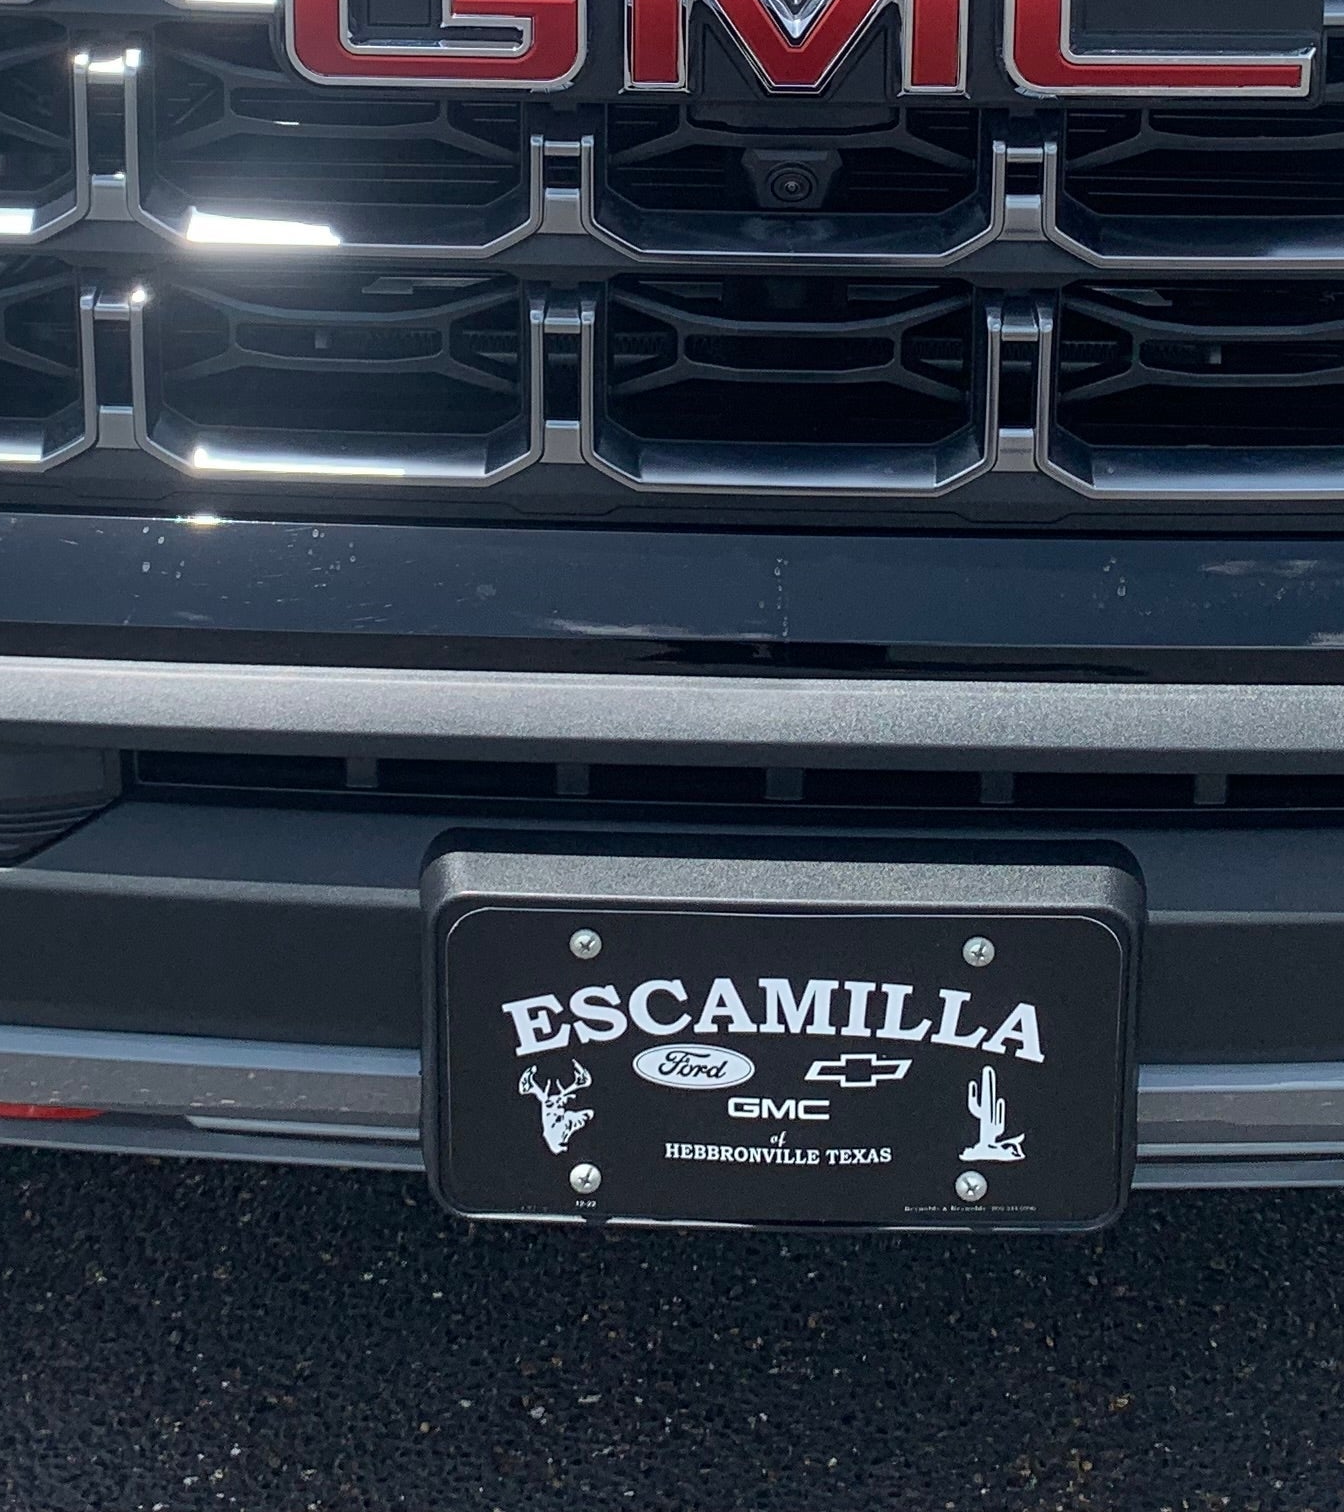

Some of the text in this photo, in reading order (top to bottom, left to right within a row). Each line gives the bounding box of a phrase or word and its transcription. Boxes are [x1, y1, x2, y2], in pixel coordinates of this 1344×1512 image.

[501, 977, 1045, 1063] ESCAMILLA
[658, 1050, 728, 1079] Ford
[727, 1096, 831, 1120] GMC
[769, 1131, 787, 1148] of
[664, 1142, 893, 1165] HEBBRONVILLE TEXAS
